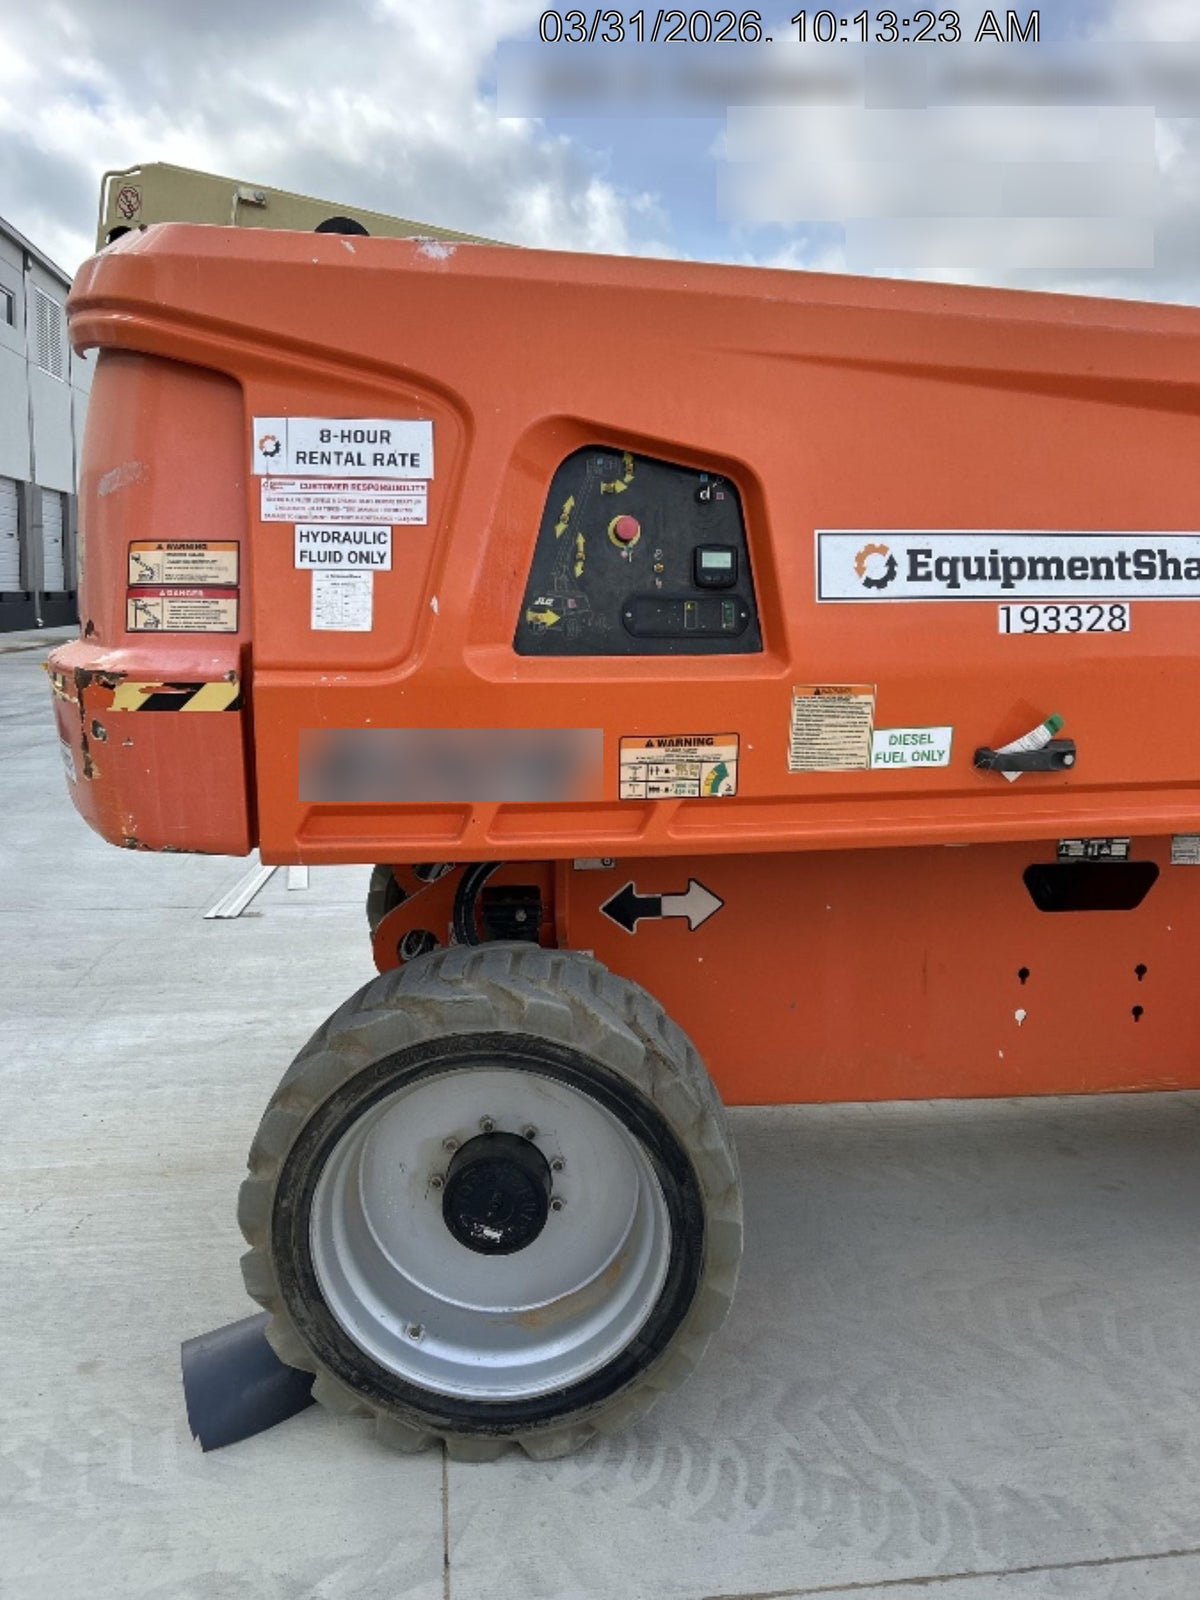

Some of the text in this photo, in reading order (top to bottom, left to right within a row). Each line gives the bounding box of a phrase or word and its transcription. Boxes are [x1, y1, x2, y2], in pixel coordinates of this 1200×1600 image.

[319, 429, 391, 444] 8-HOUR
[295, 451, 420, 468] RENTAL RATE
[299, 531, 388, 545] HYDRAULIC
[299, 550, 387, 565] FLUID ONLY
[1001, 604, 1126, 634] 193328
[657, 738, 714, 748] WARNING
[888, 733, 934, 746] DIESEL
[874, 750, 946, 764] FUEL ONLY
